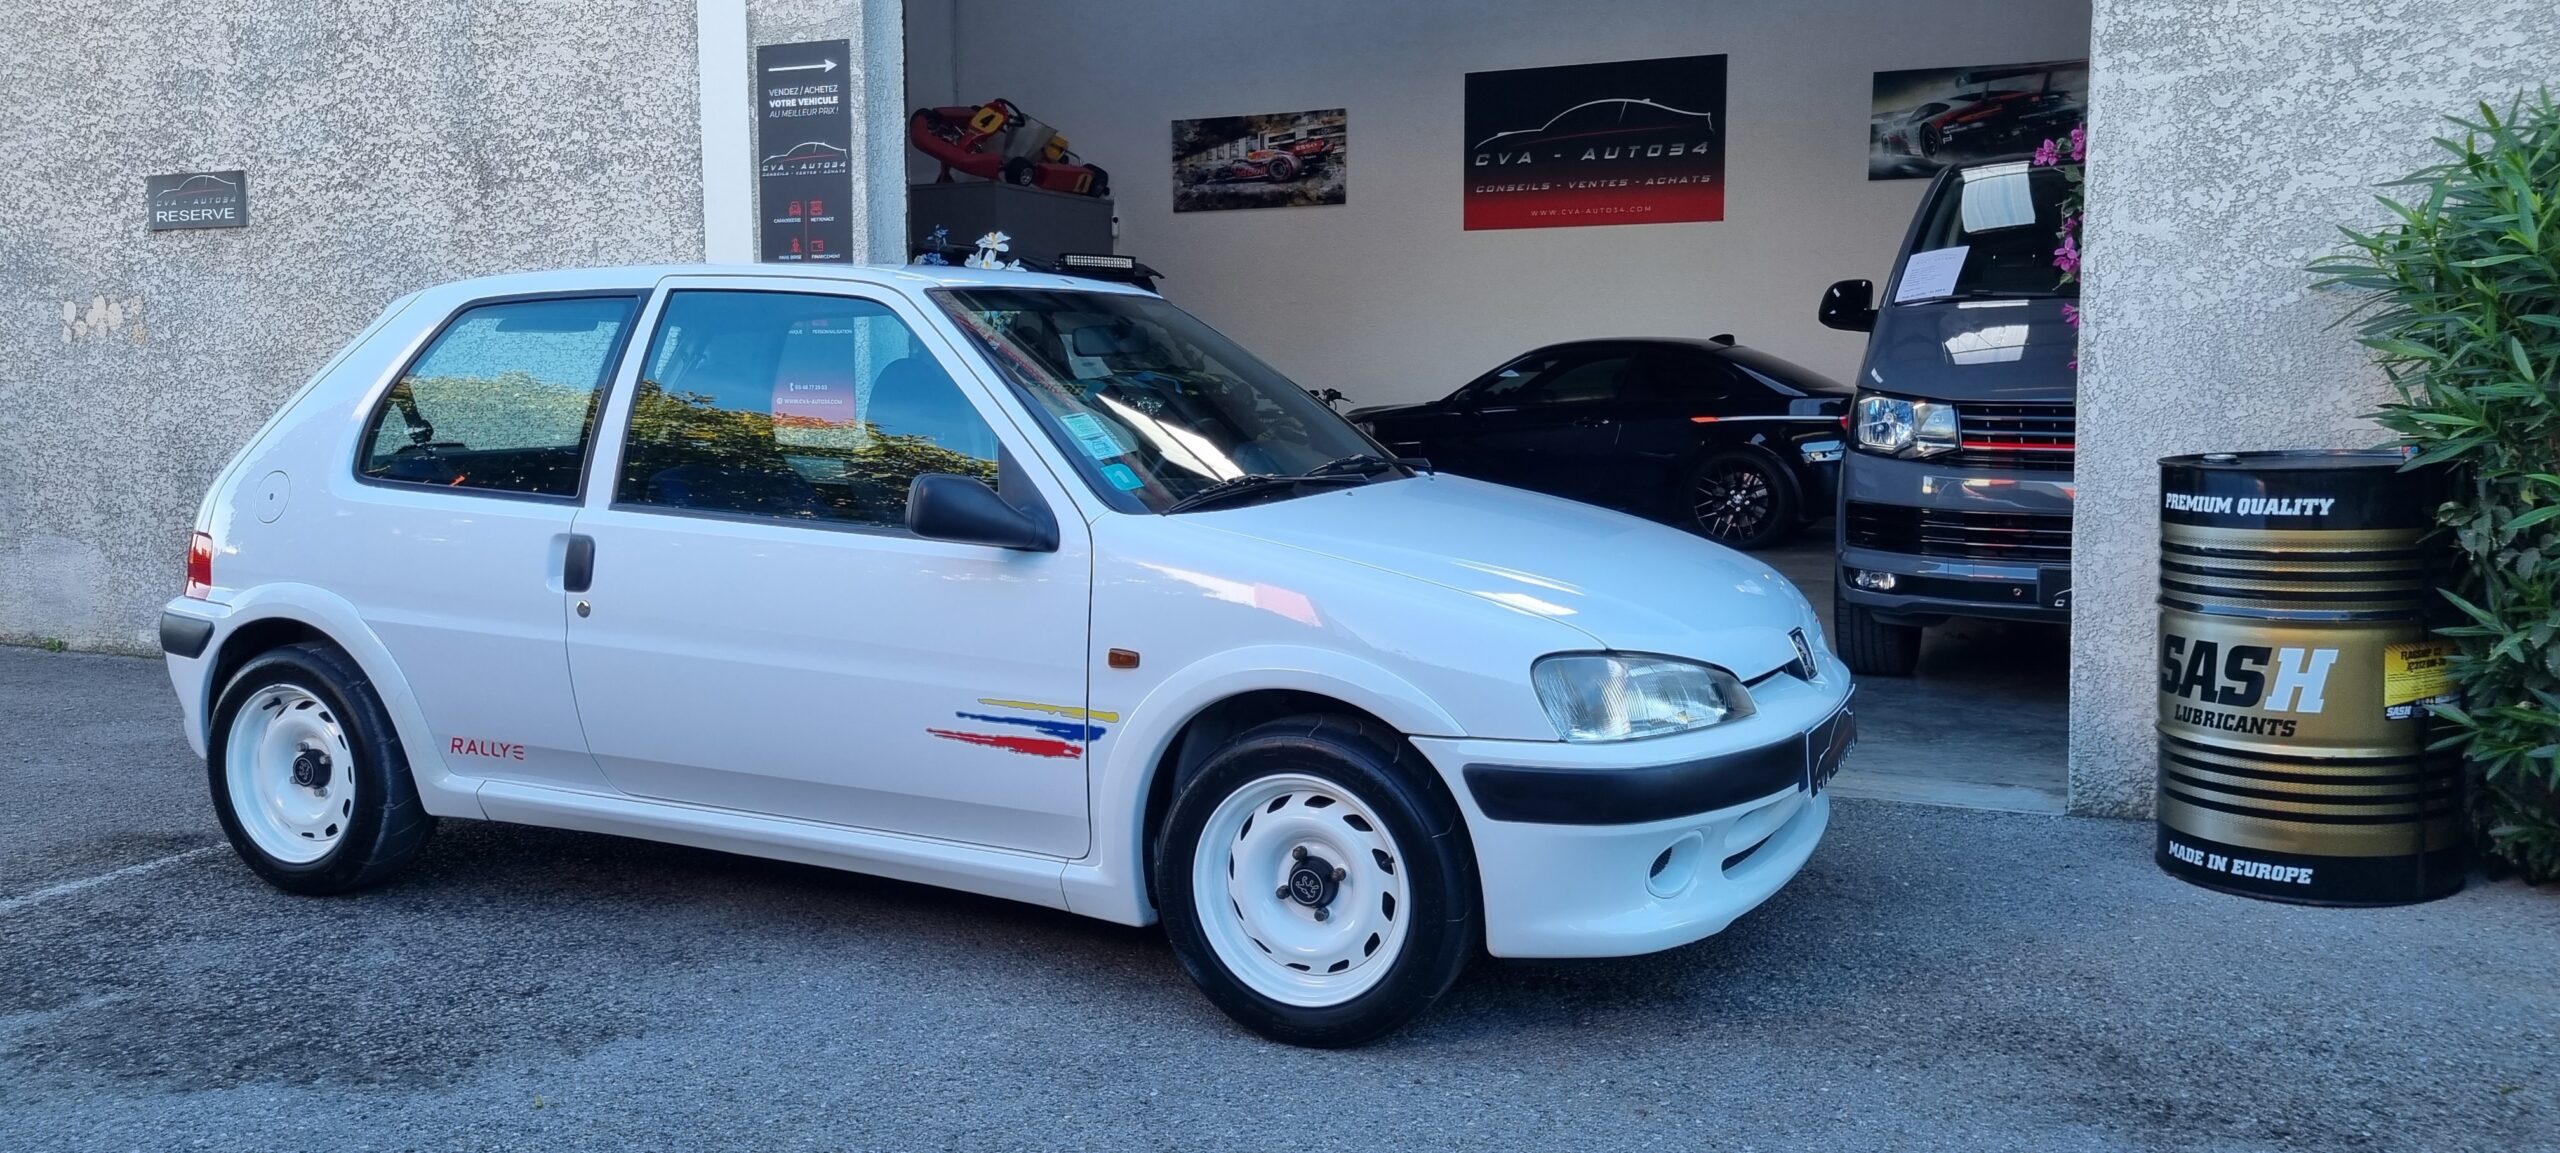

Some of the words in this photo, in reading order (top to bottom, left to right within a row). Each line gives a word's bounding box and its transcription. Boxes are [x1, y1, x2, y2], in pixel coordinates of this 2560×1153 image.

[769, 88, 799, 96] VENDEZ
[804, 85, 838, 94] ACHETEZ
[769, 98, 797, 108] VOTRE
[798, 96, 838, 106] VEHICULE
[769, 110, 780, 118] AU
[781, 108, 817, 117] MEILLEUR
[818, 106, 835, 114] PRIX
[980, 114, 996, 128] 4
[1475, 152, 1532, 166] CVA
[1581, 142, 1709, 161] AUTO34
[762, 164, 784, 172] CVA
[801, 161, 846, 170] AUTO34
[1475, 182, 1551, 193] CONSEILS
[1568, 178, 1628, 189] VENTES
[1645, 175, 1711, 185] ACHATS
[193, 196, 236, 205] AUTO34
[156, 208, 235, 222] RESERVE
[1531, 206, 1652, 216] WWW.CVA-AUTO34.COM
[2165, 492, 2232, 514] PREMIUM
[2236, 497, 2335, 517] QUALITY
[2160, 633, 2339, 714] SASH
[2386, 705, 2412, 717] SASH
[2174, 703, 2297, 738] LUBRICANTS
[450, 737, 524, 760] RALLYE
[2168, 840, 2205, 866] MADE
[2207, 853, 2228, 872] IN
[2231, 858, 2314, 885] EUROPE
